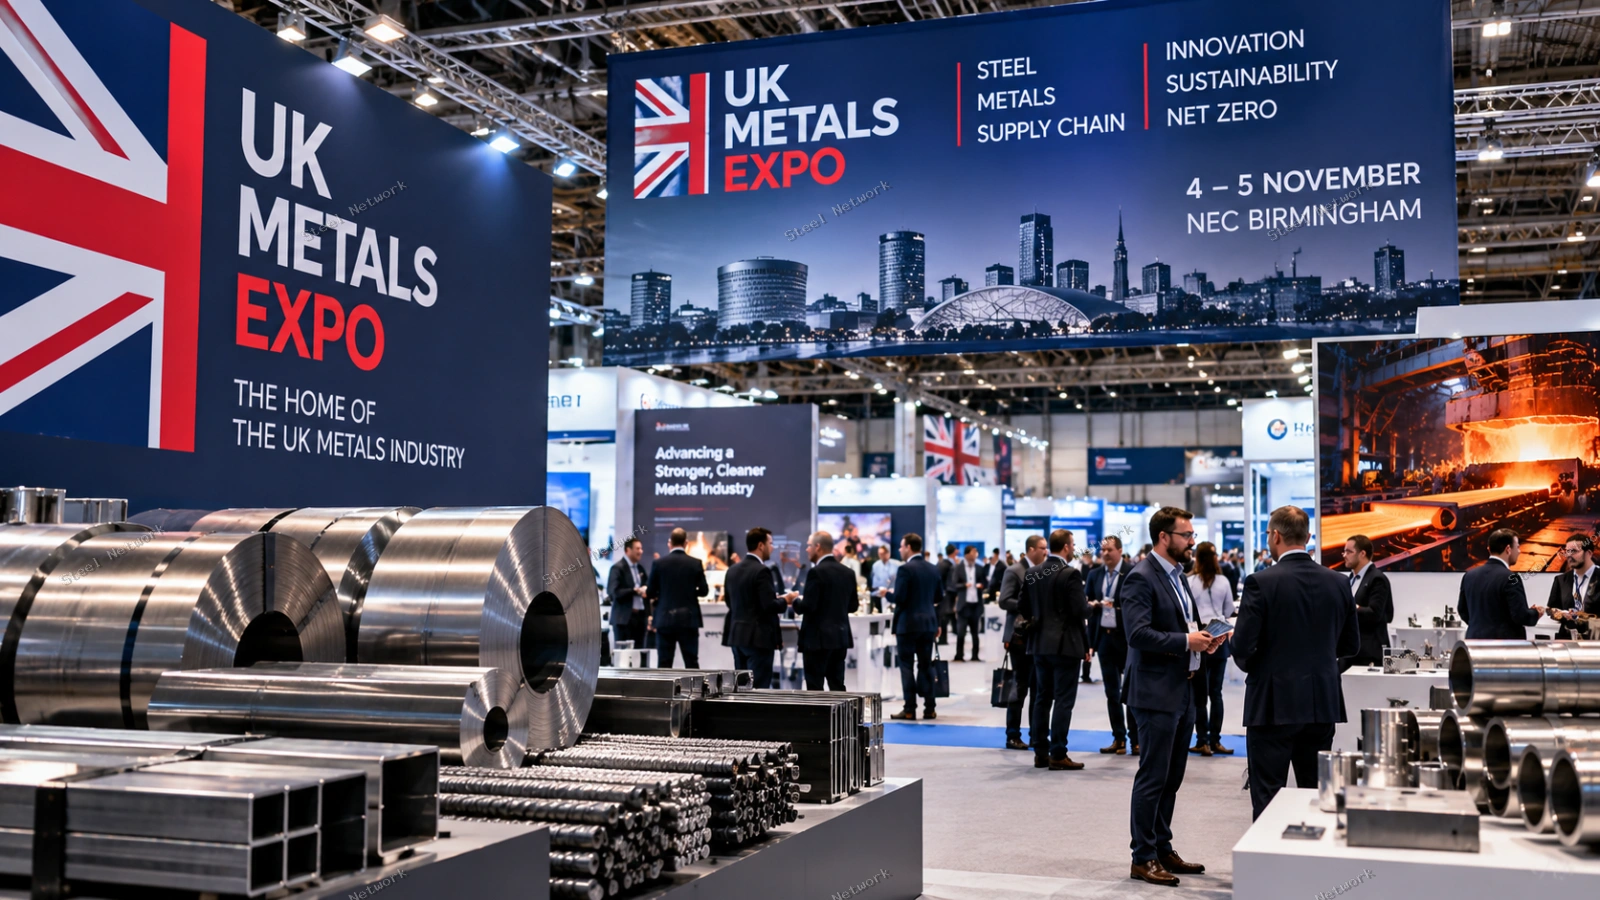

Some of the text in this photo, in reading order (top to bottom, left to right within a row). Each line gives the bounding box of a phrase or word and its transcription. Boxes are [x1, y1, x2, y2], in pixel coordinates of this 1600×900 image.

[1167, 29, 1303, 60] INNOVATION
[726, 65, 789, 106] UK
[978, 57, 1036, 79] STEEL
[1167, 60, 1338, 93] SUSTAINABILITY
[978, 87, 1055, 110] METALS
[1168, 100, 1277, 126] NET ZERO
[725, 98, 898, 148] METALS
[978, 113, 1124, 142] SUPPLY CHAIN
[242, 88, 332, 199] UK
[725, 147, 845, 192] EXPO
[1187, 178, 1202, 198] 4
[1238, 174, 1252, 195] 5
[1264, 163, 1420, 194] NOVEMBER
[1188, 199, 1421, 234] NEC BIRMINGHAM
[239, 185, 437, 307] METALS
[236, 273, 384, 370] EXPO
[234, 379, 376, 424] THE HOME OF
[233, 419, 464, 468] THE UK METALS INDUSTRY
[655, 446, 734, 461] Advancing a
[655, 463, 766, 480] Stronger, Cleaner
[655, 482, 754, 497] Metals Industry
